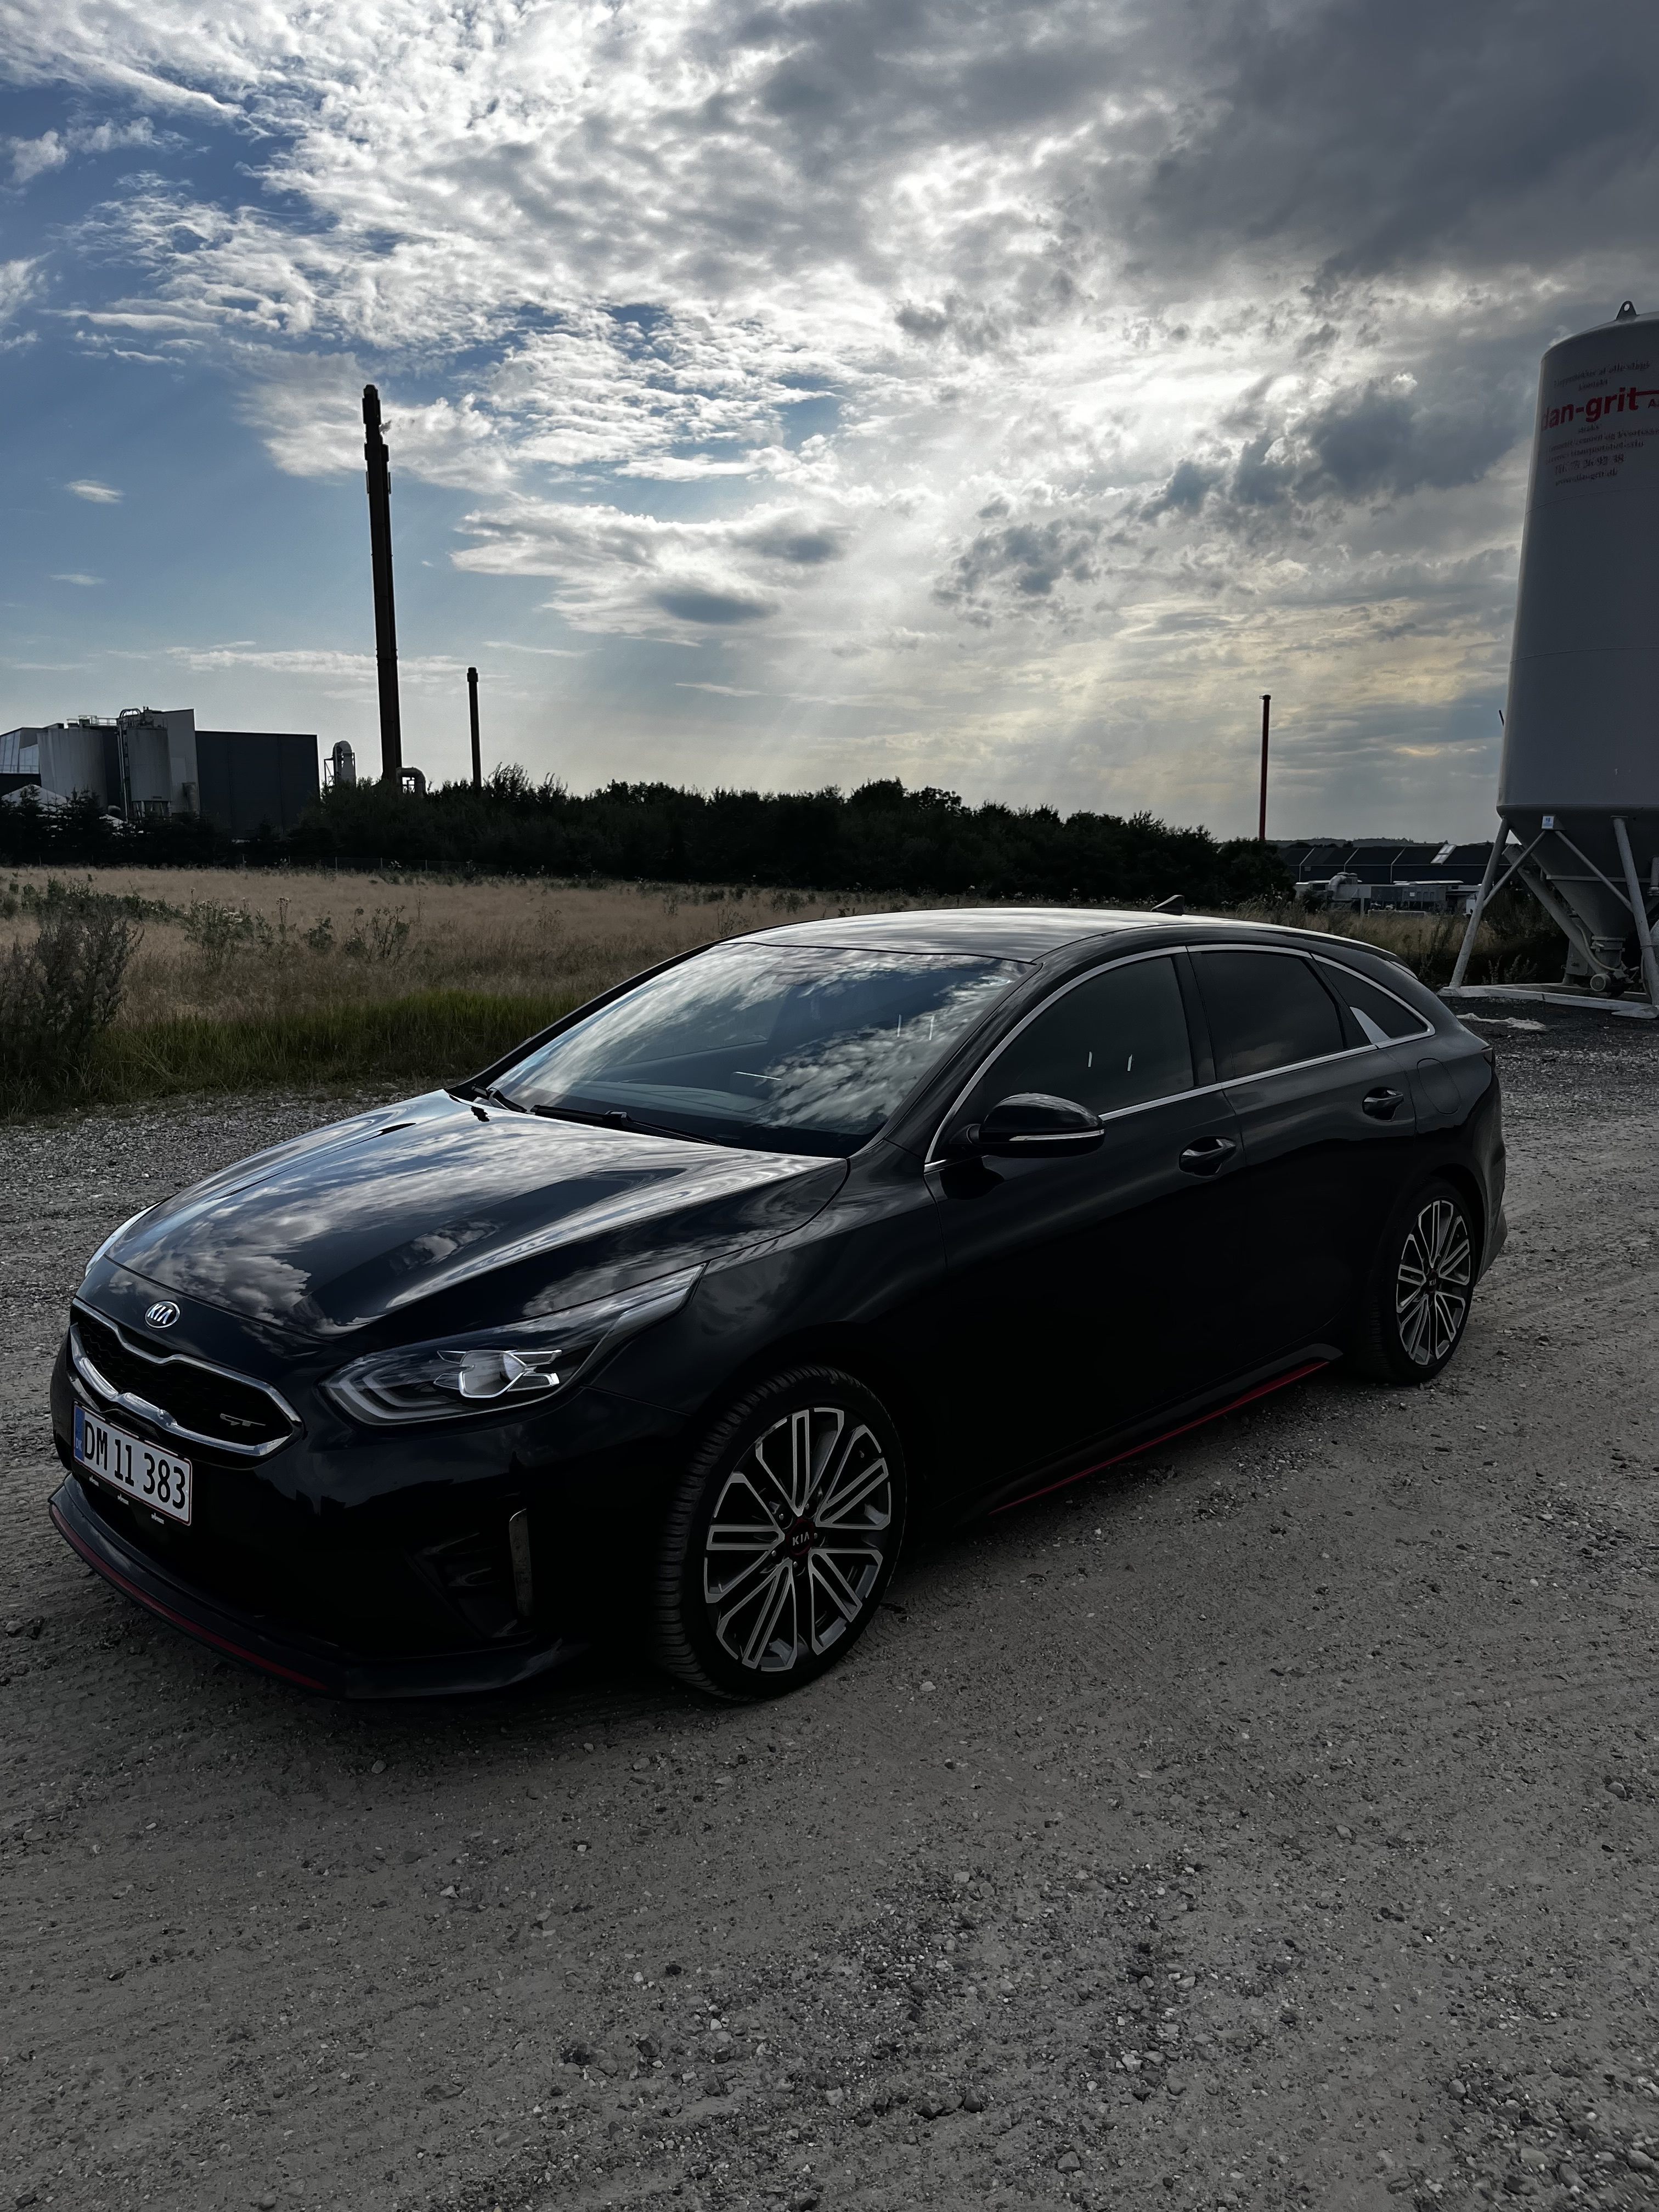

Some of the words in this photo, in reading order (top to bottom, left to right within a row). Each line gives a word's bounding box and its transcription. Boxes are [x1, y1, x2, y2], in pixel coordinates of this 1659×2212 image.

[1541, 387, 1639, 431] dan-grit
[147, 1304, 173, 1324] KIA
[75, 1437, 82, 1452] DK
[84, 1419, 108, 1471] DM
[114, 1438, 134, 1487] 11
[143, 1452, 185, 1509] 383
[792, 1532, 810, 1546] KIA
